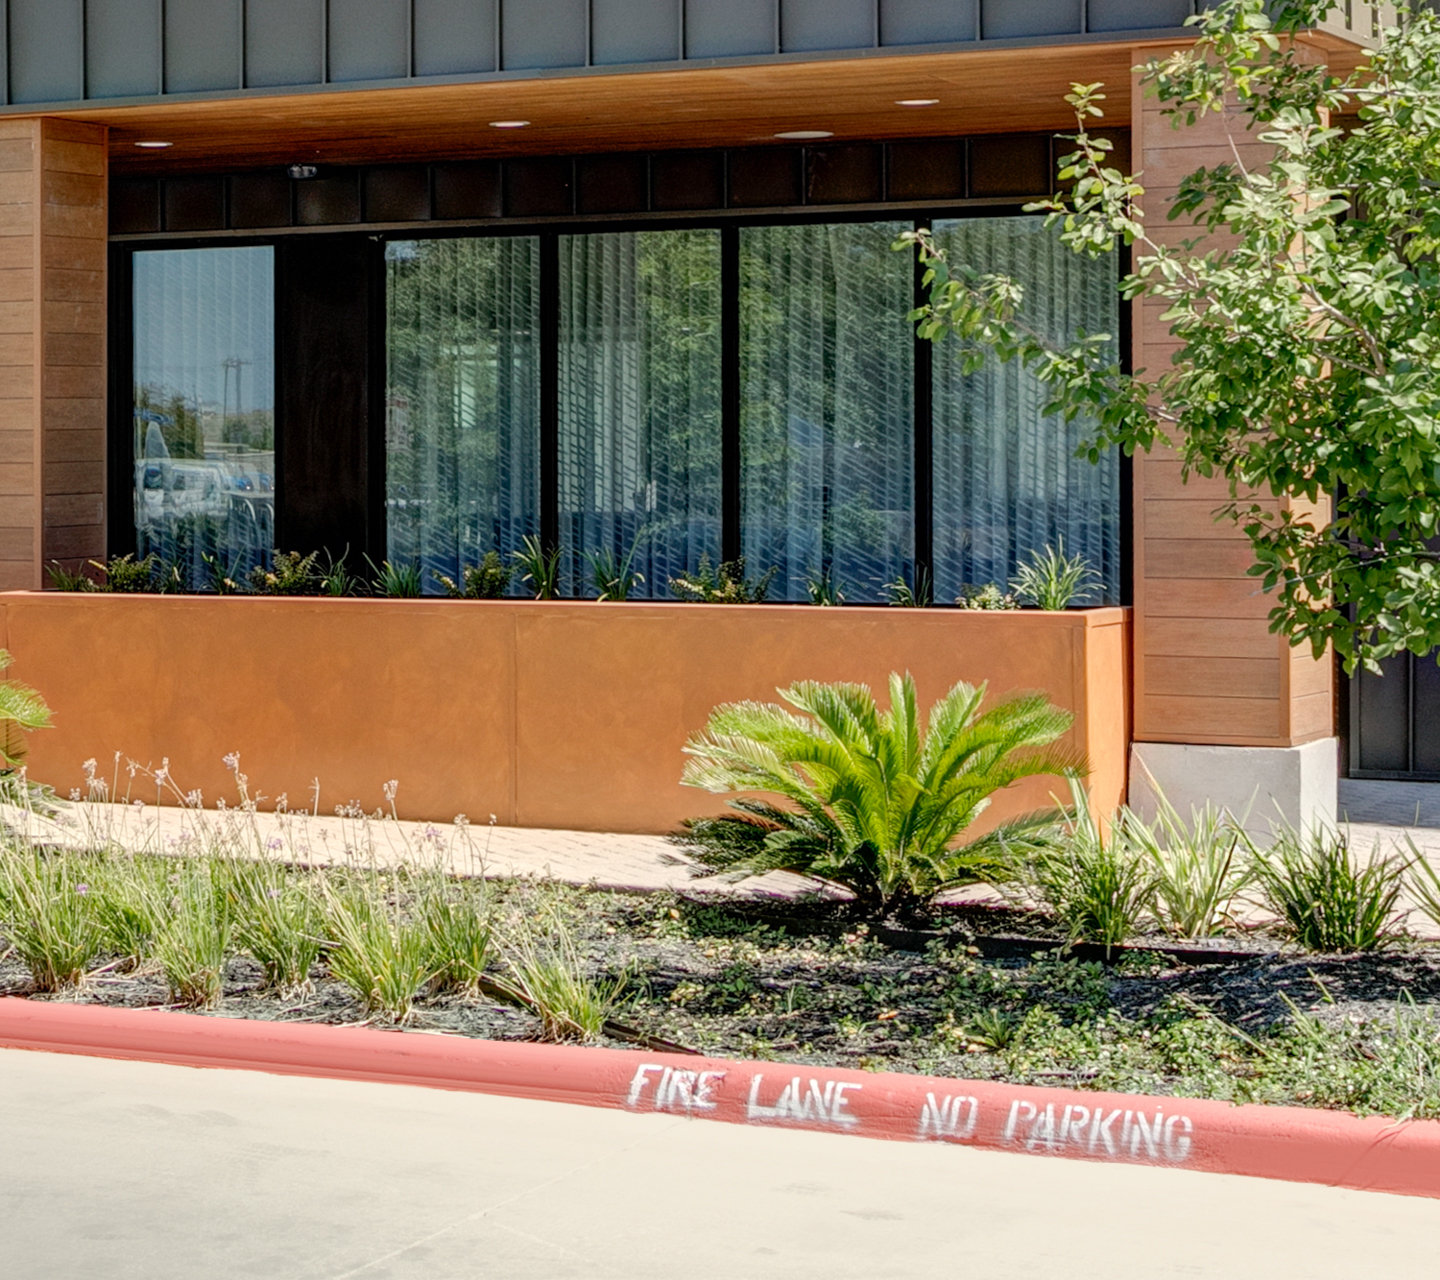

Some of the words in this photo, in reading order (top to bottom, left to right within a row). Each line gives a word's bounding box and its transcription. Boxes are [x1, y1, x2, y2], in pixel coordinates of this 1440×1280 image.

[628, 1062, 727, 1110] FIRE
[747, 1074, 863, 1127] LANE
[920, 1092, 979, 1139] NO
[1002, 1099, 1194, 1162] PARKING
